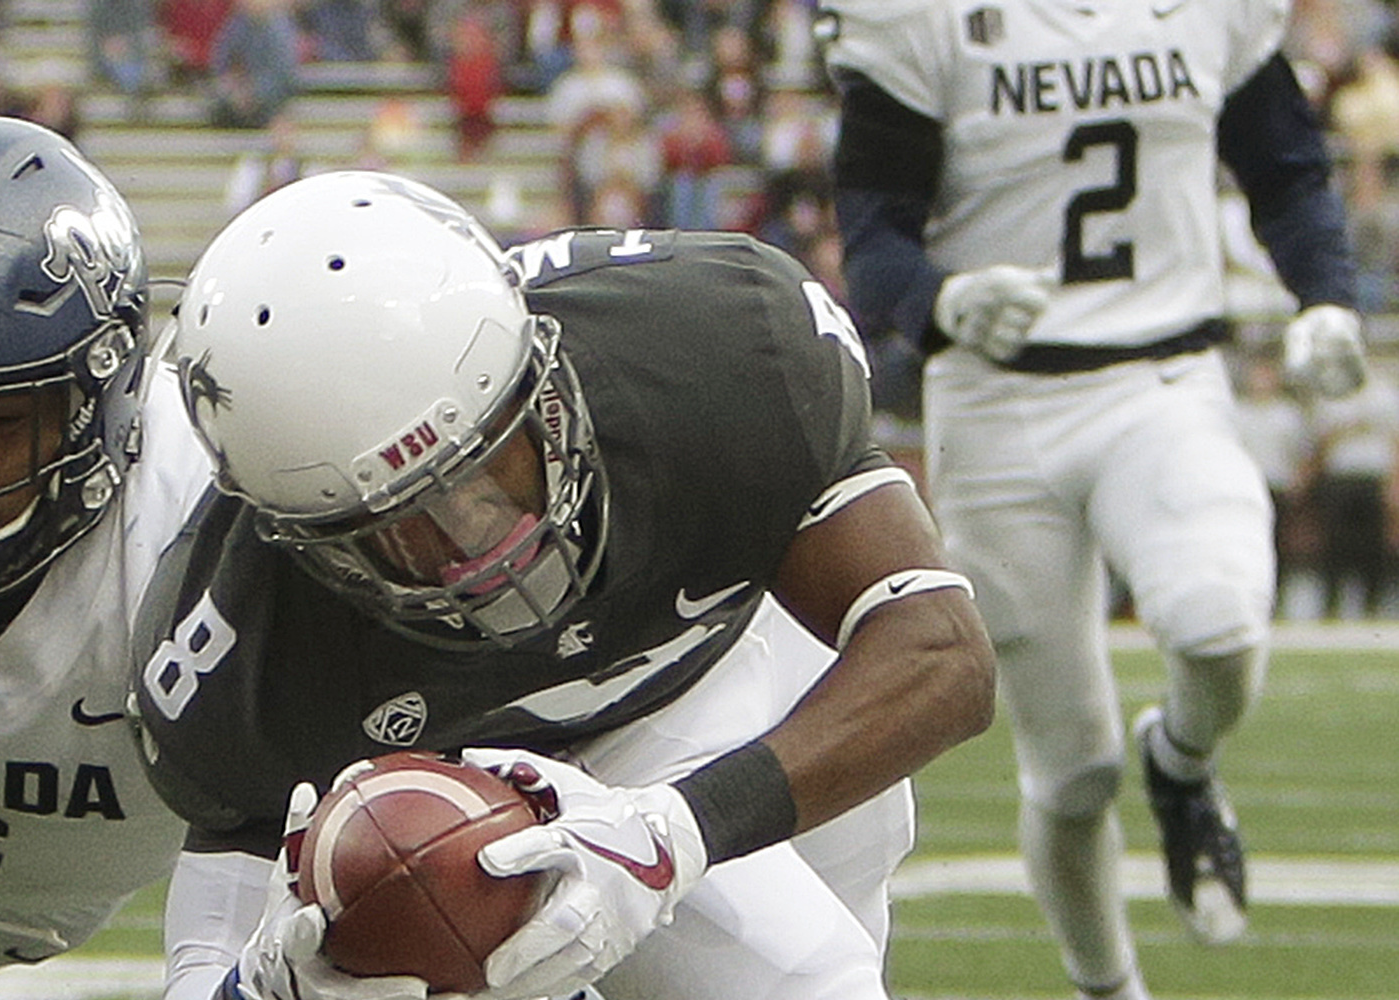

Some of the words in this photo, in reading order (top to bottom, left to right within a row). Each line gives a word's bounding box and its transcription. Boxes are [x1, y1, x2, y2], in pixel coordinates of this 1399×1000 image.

[991, 49, 1200, 115] NEVADA
[1062, 118, 1139, 284] 2
[378, 420, 440, 471] WSU
[143, 587, 238, 721] 8
